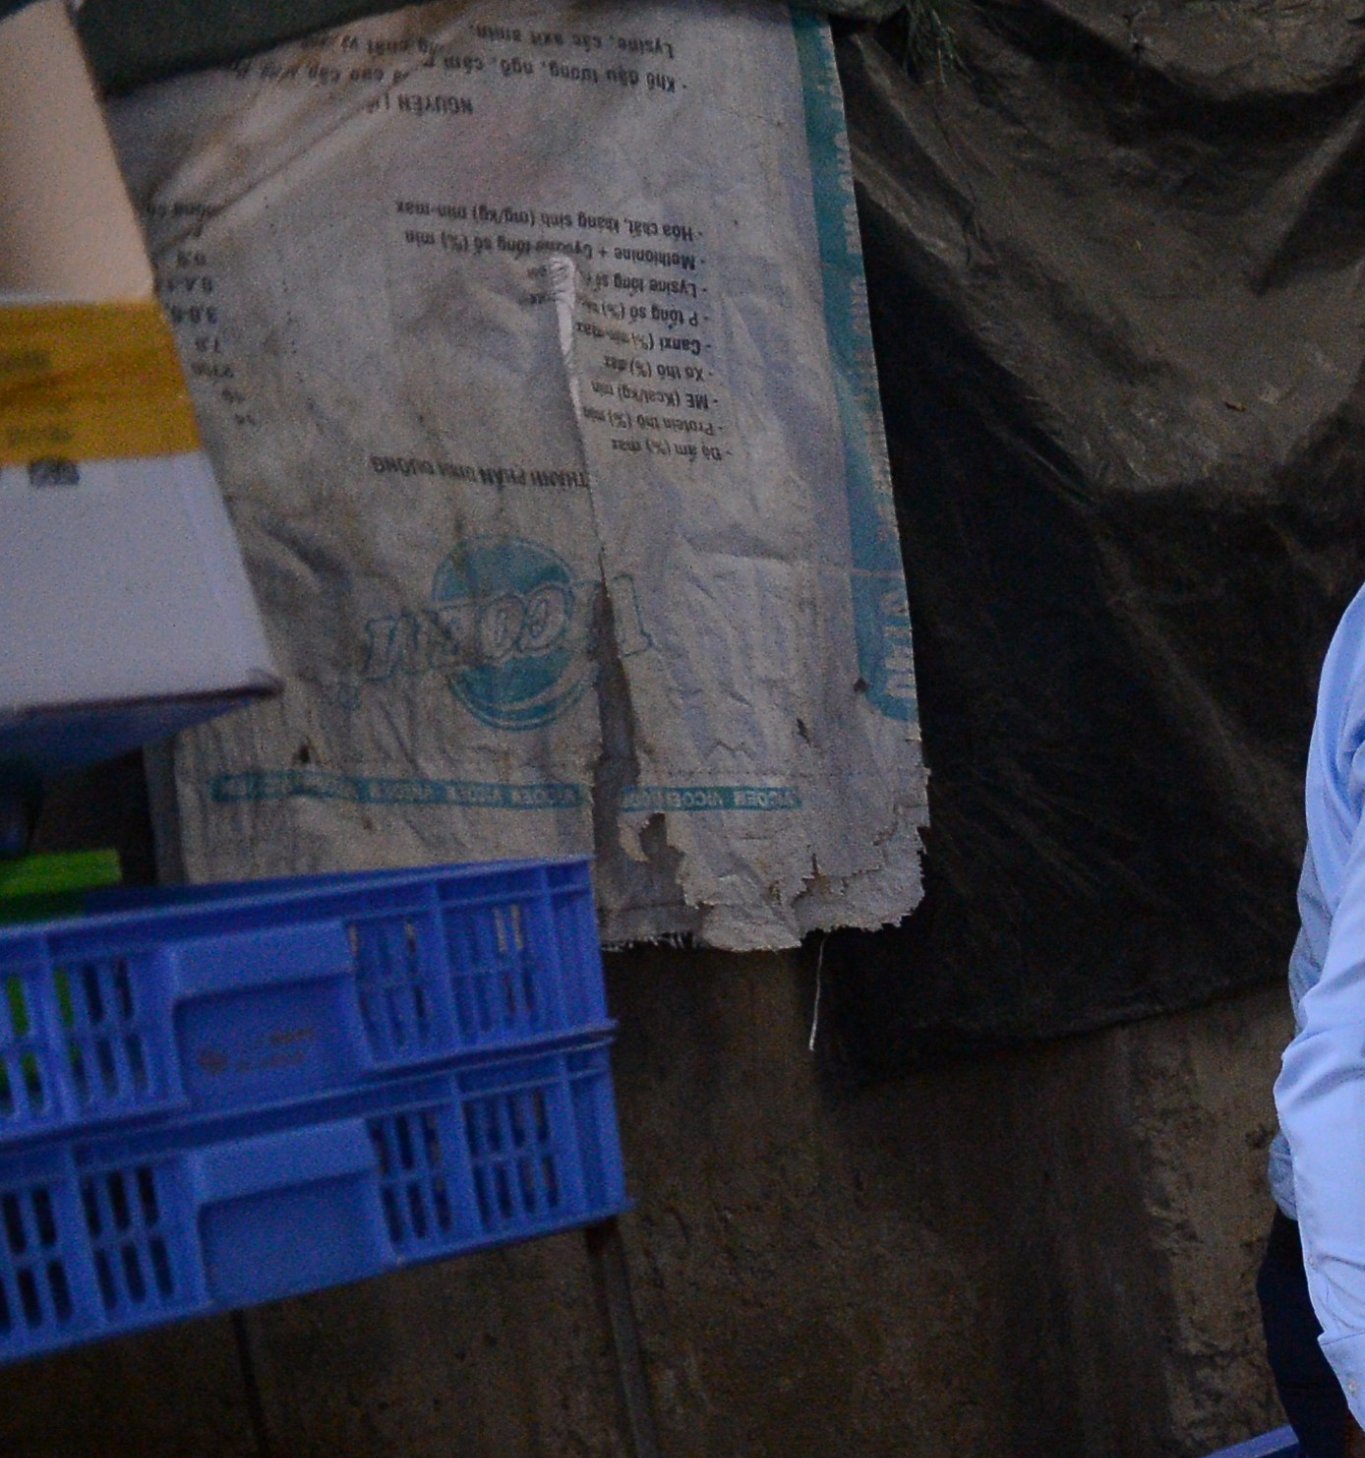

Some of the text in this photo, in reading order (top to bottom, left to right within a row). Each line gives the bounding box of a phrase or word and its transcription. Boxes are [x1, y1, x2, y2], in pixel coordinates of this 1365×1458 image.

[404, 230, 436, 248] min
[613, 247, 696, 271] Methionine
[649, 279, 698, 299] Lysine
[689, 311, 699, 327] P
[659, 337, 701, 356] Canxi
[684, 393, 709, 411] ME
[662, 417, 715, 437] Protein
